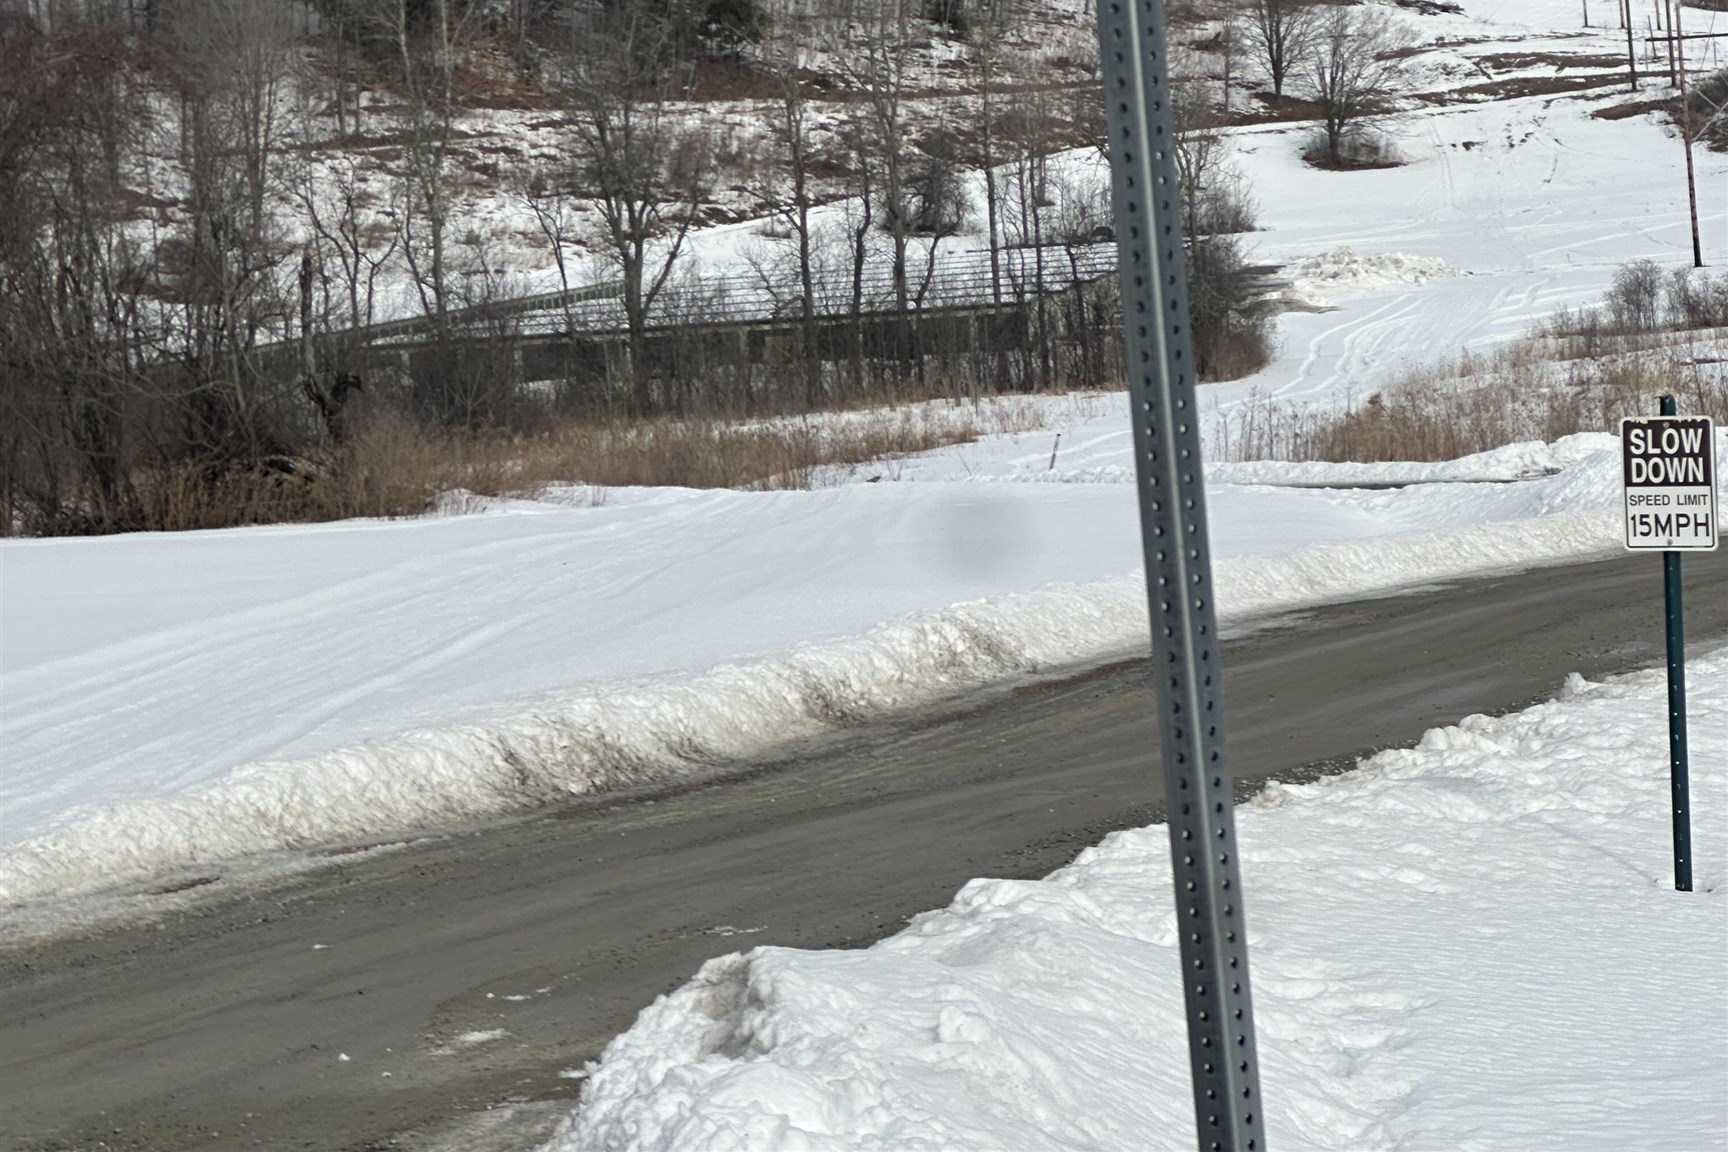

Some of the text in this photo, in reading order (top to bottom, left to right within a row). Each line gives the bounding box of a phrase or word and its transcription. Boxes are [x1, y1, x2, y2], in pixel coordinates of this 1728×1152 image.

[1629, 428, 1703, 455] SLOW
[1631, 457, 1705, 484] DOWN
[1629, 494, 1709, 506] SPEED LIMIT
[1630, 513, 1710, 537] 15MPH
